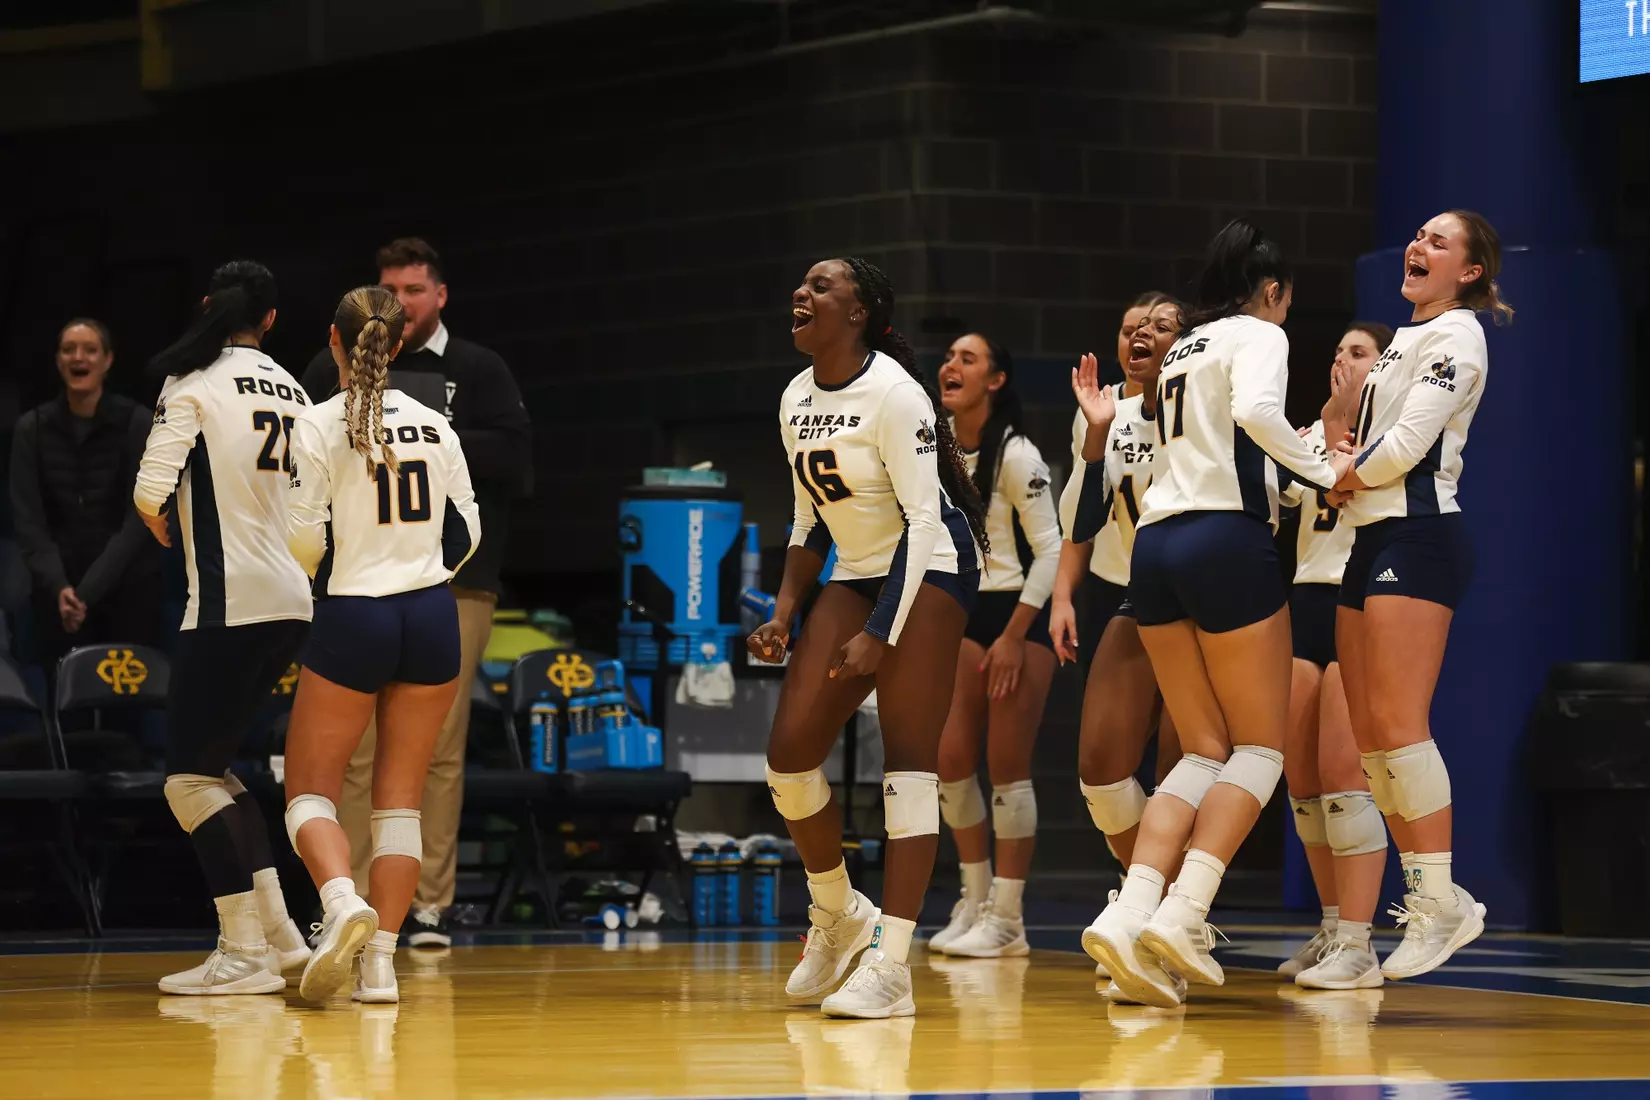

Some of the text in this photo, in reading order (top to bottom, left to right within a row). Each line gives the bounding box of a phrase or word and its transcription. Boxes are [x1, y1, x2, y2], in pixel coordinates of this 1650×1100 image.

[233, 376, 306, 407] ROOS
[1421, 375, 1457, 393] ROOS
[789, 414, 862, 428] KANSAS
[1156, 371, 1189, 447] 17
[798, 427, 840, 440] CITY
[371, 458, 432, 526] 10
[794, 448, 855, 507] 16
[687, 508, 704, 620] POWERADE
